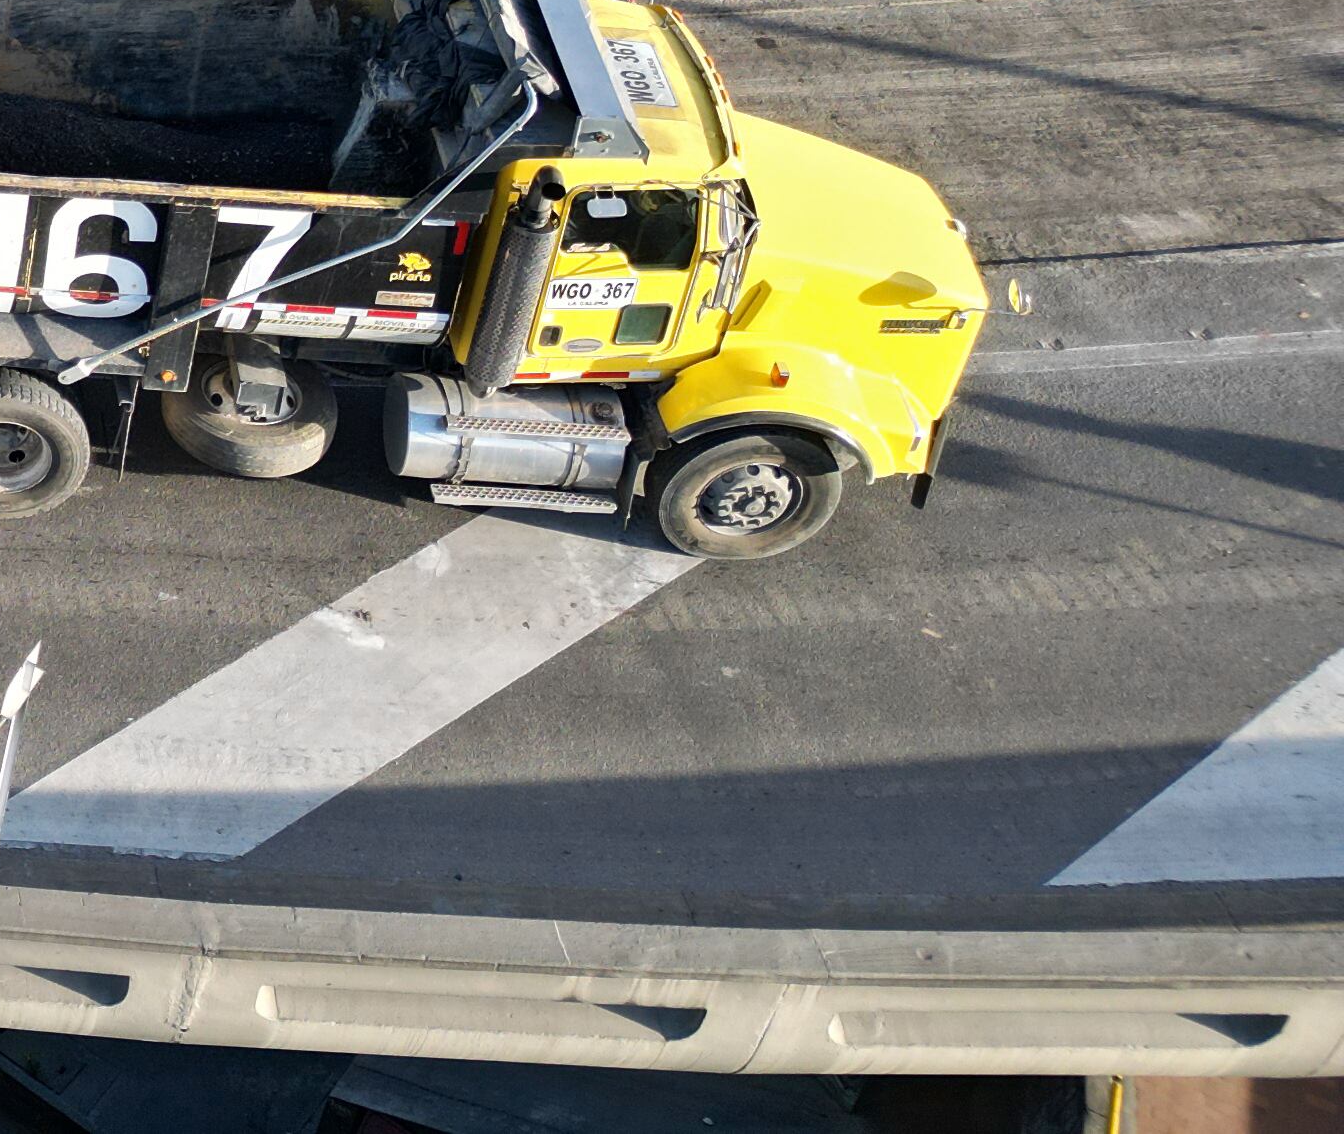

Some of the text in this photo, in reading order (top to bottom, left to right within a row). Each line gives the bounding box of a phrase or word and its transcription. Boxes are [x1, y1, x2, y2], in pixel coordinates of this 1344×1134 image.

[606, 39, 656, 102] WGO 367
[551, 282, 634, 300] WGO 367
